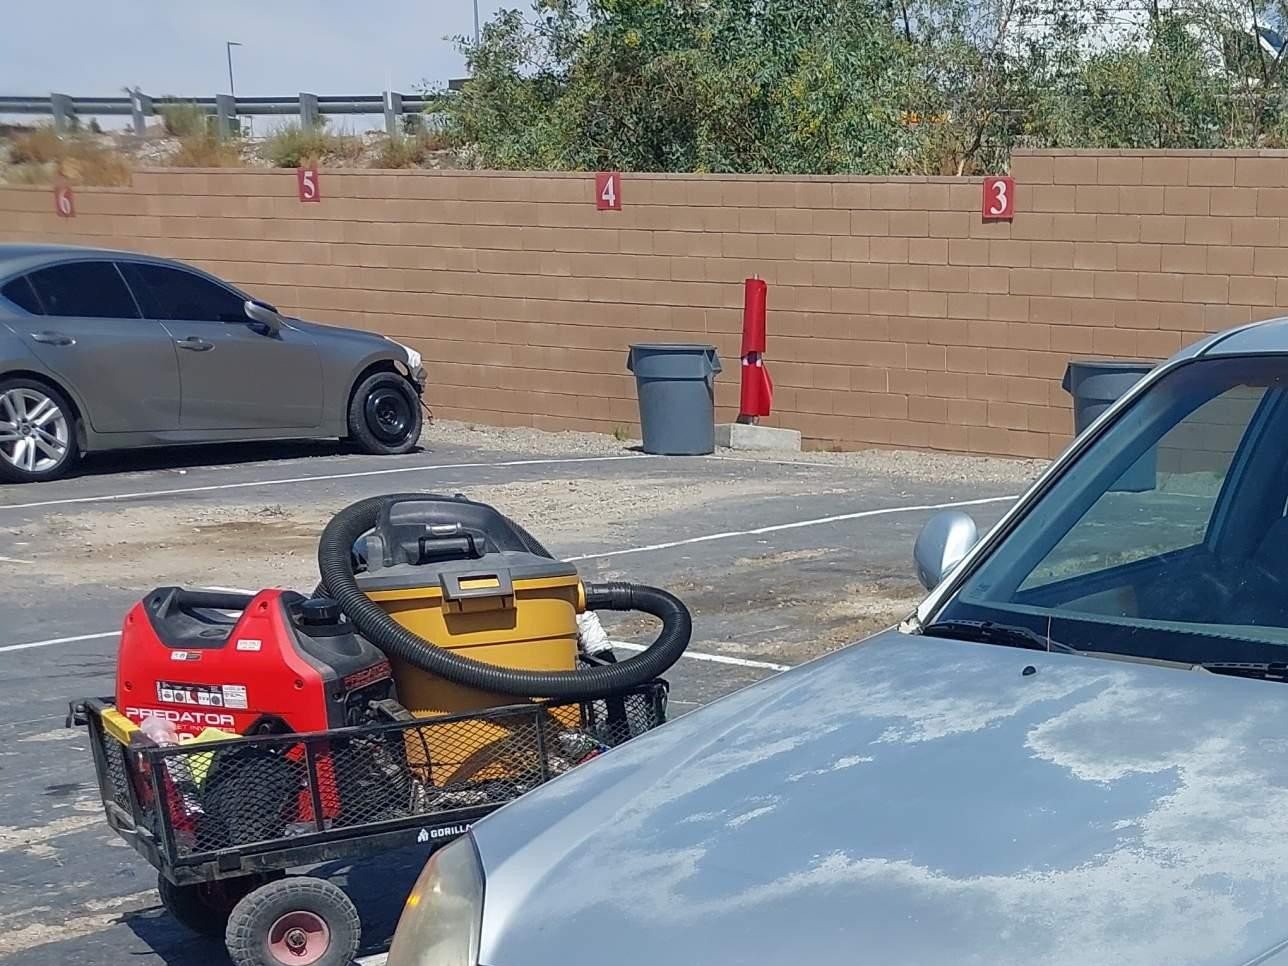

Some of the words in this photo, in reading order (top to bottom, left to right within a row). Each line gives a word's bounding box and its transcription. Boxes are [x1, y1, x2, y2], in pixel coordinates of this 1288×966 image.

[303, 171, 315, 198] 5
[602, 175, 616, 207] 4
[990, 180, 1007, 215] 3
[59, 188, 71, 215] 6
[126, 707, 235, 725] PREDATOR
